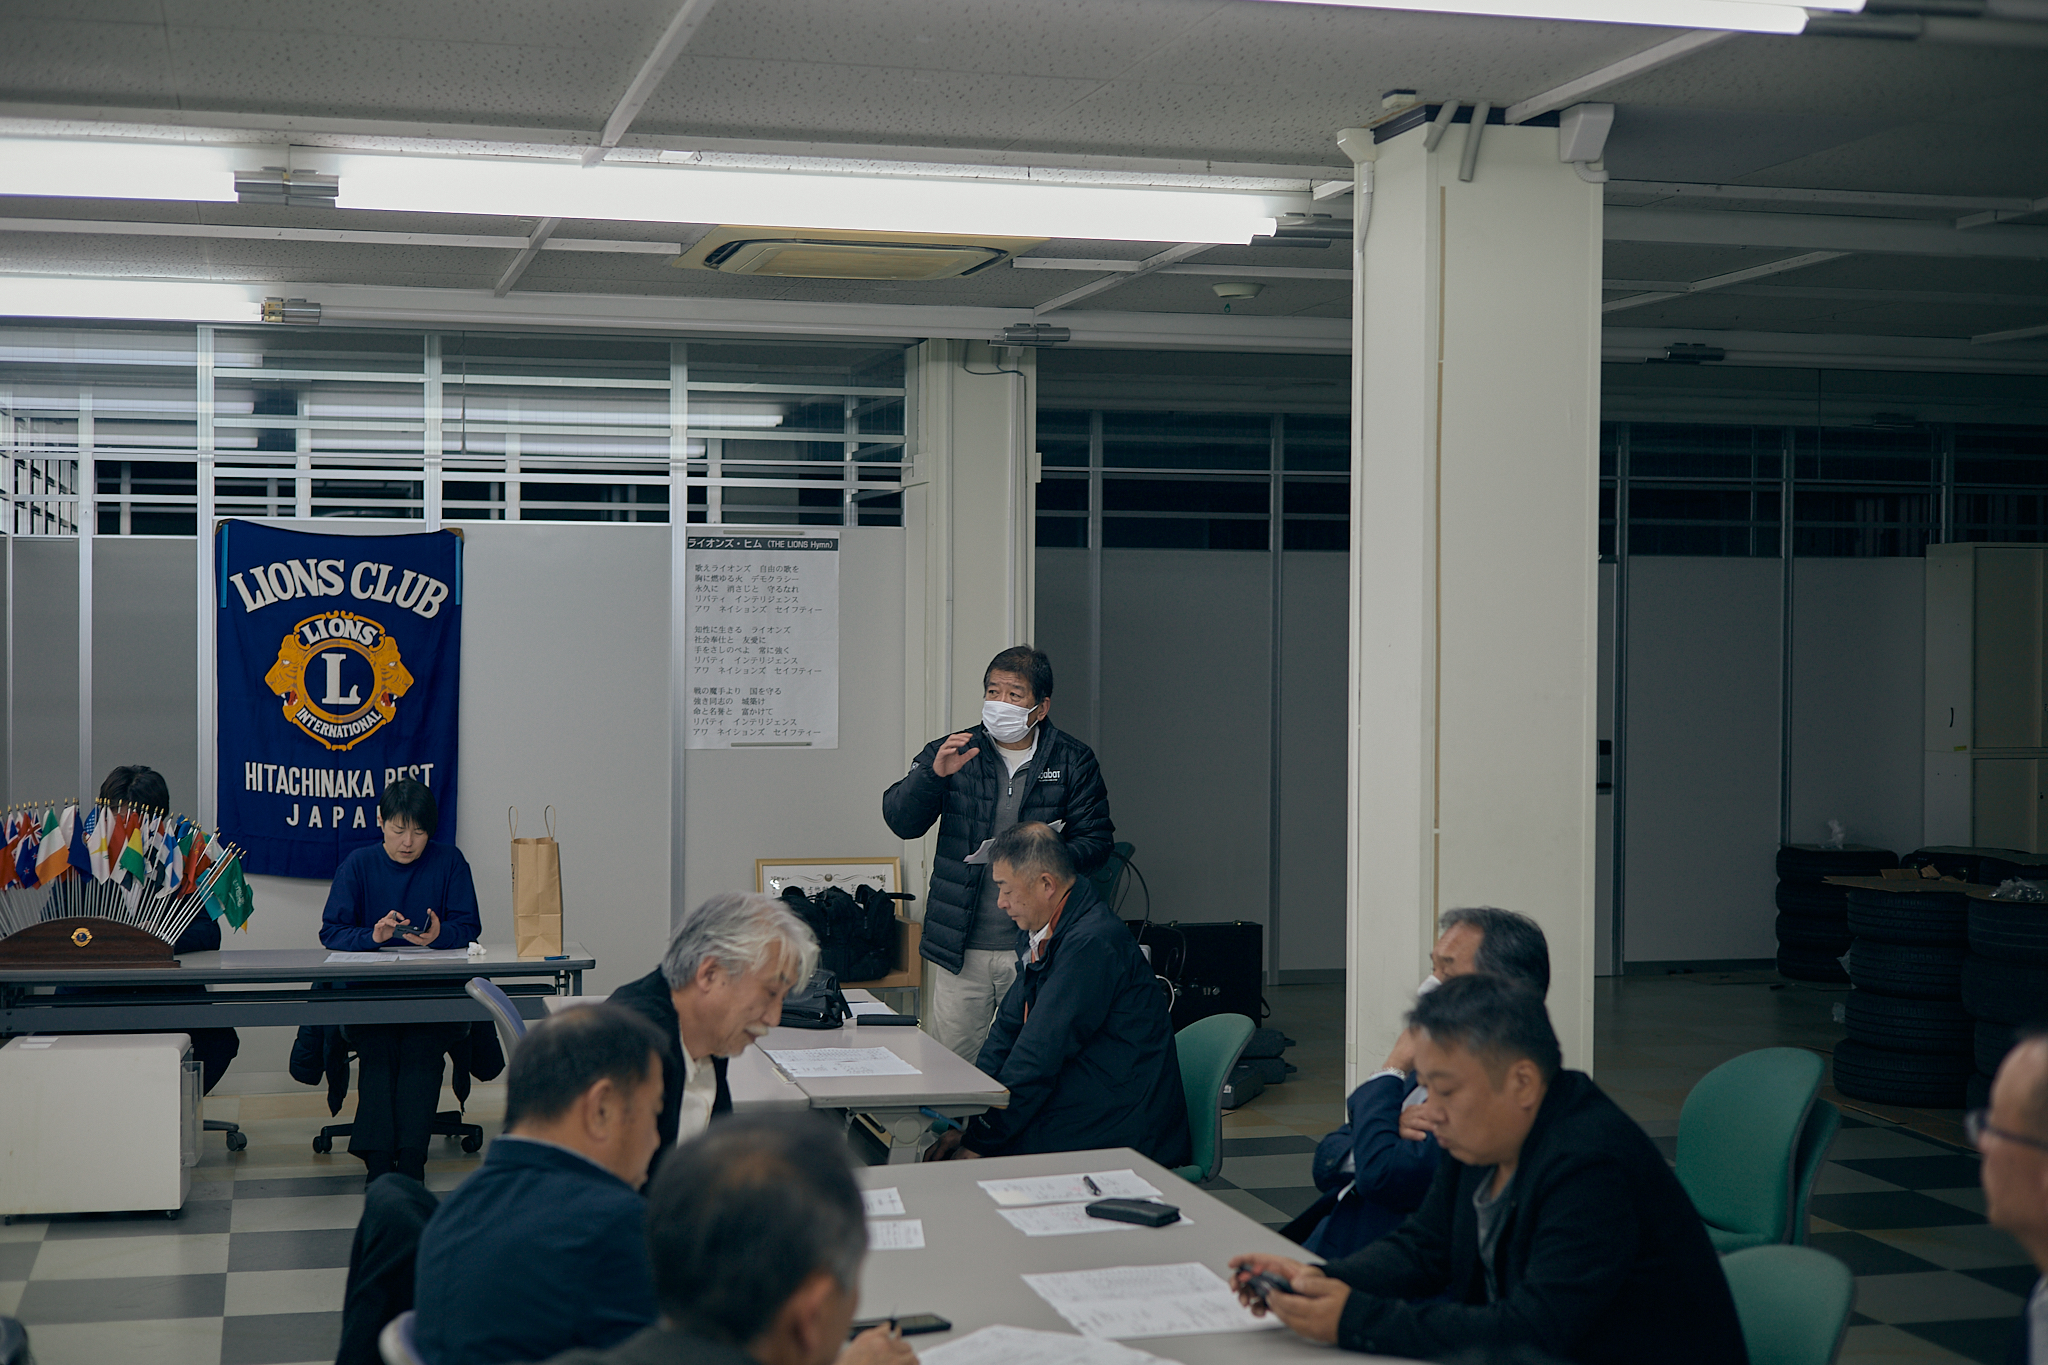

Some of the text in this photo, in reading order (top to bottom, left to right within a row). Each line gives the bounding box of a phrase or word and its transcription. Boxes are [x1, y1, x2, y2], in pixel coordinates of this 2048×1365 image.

[688, 538, 762, 549] ライオンズ・ヒム
[787, 540, 808, 549] LIONS
[229, 558, 449, 619] LIONS CLUB
[300, 617, 379, 646] LIONS
[321, 653, 361, 704] L
[296, 707, 382, 738] INTERNATIONAL
[245, 762, 375, 798] HITACHINAKA
